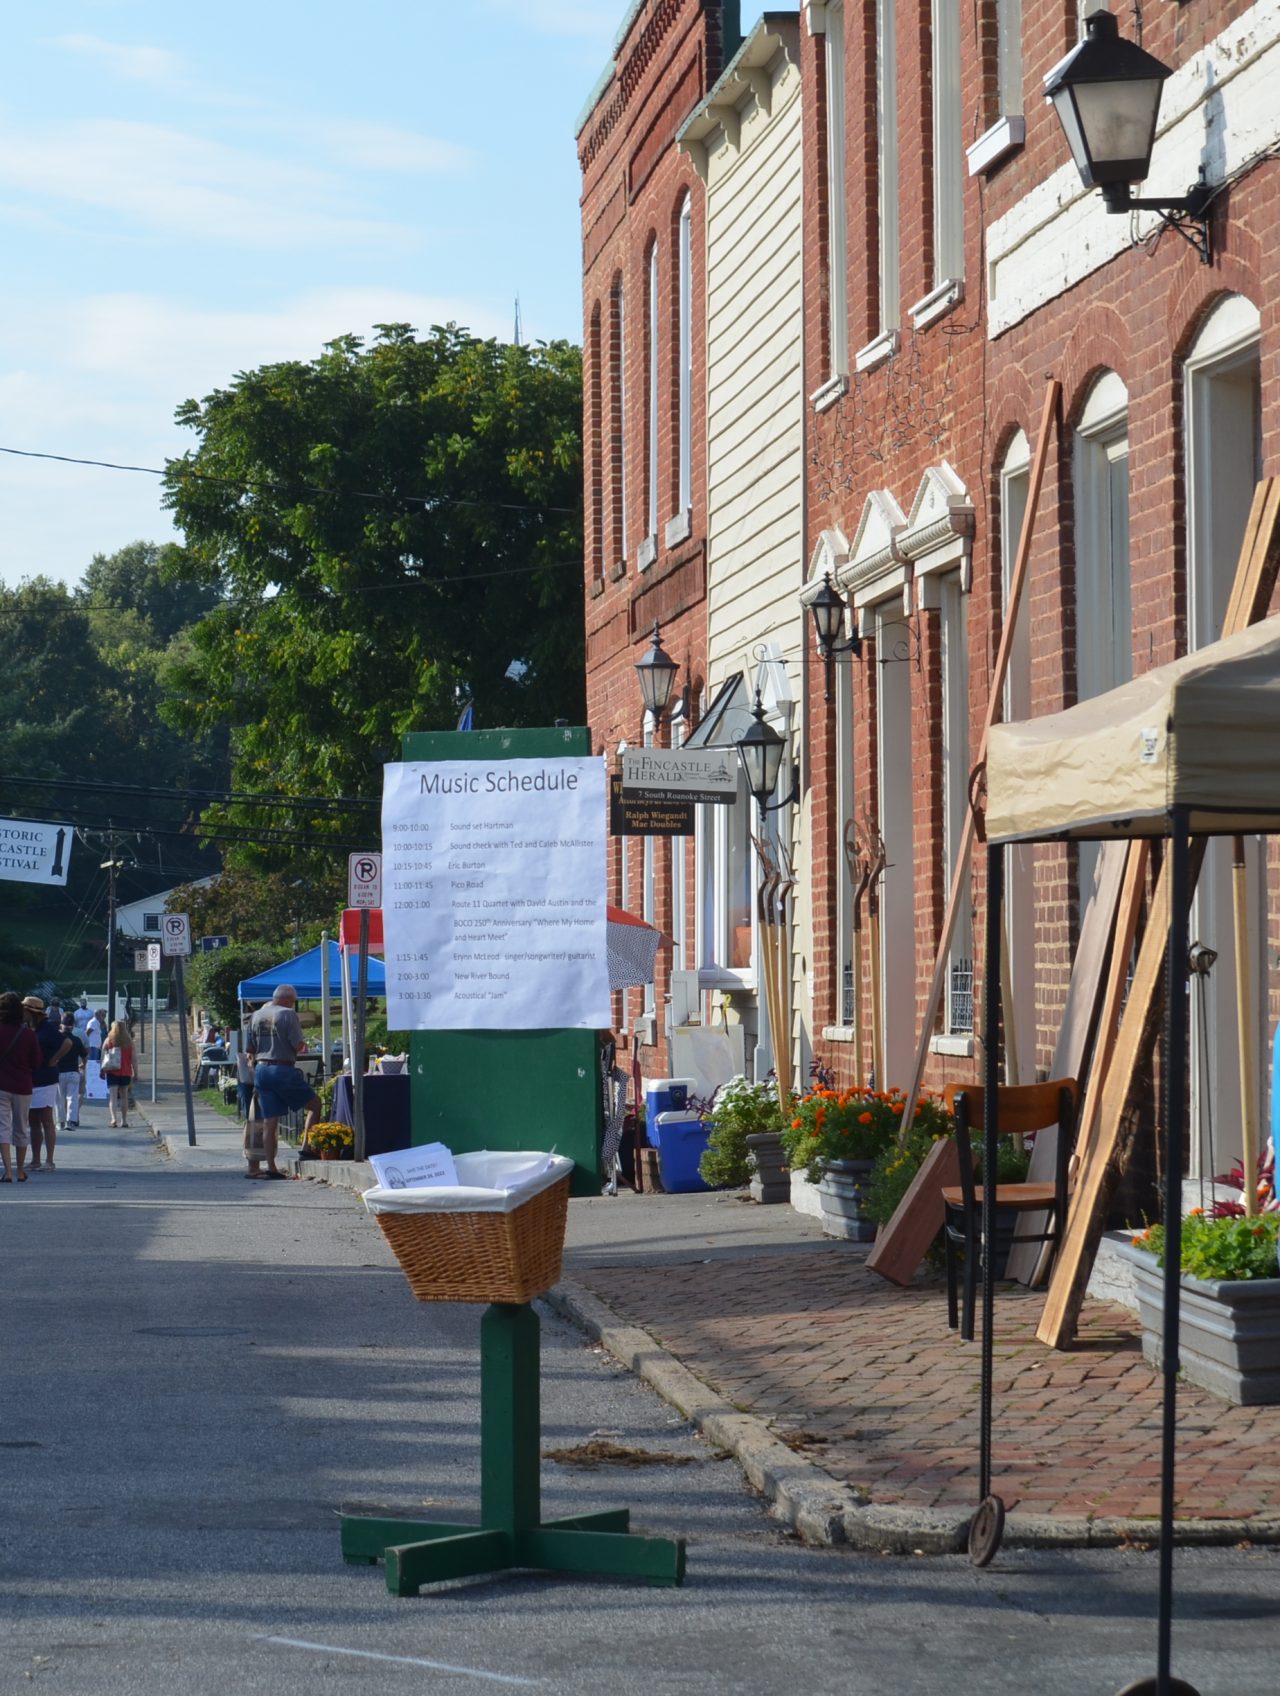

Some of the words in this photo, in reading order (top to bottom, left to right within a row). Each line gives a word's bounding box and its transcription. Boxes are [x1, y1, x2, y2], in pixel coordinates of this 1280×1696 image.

[641, 757, 712, 772] FINCASTLE
[628, 767, 683, 782] HERALD
[420, 772, 480, 795] Music
[484, 768, 578, 793] Schedule
[644, 791, 665, 799] South
[666, 791, 699, 800] Roanoke
[700, 792, 721, 801] Street
[625, 811, 649, 821] Ralph
[392, 823, 429, 832] 9:00-10:00
[450, 822, 471, 831] Sound
[484, 822, 514, 830] Hartman
[650, 820, 682, 828] Doubles
[393, 842, 433, 851] 10:00-10:15
[450, 842, 471, 850] Sound
[472, 841, 492, 850] check
[493, 841, 509, 849] with
[510, 840, 523, 848] Ted
[524, 840, 538, 848] and
[539, 840, 559, 848] Caleb
[560, 839, 594, 848] McAllister
[393, 862, 432, 871] 10:15-10:45
[448, 861, 461, 870] Eric
[462, 861, 486, 870] Burton
[394, 881, 434, 890] 11:00-11:45
[450, 880, 465, 889] Pico
[466, 880, 484, 889] Road
[394, 900, 431, 909] 12:00-1:00
[451, 900, 471, 909] Route
[472, 900, 480, 908] 11
[482, 900, 508, 909] Quartet
[509, 899, 526, 908] with
[526, 899, 546, 907] David
[548, 898, 569, 907] Austin
[570, 898, 583, 906] and
[585, 898, 597, 906] the
[493, 919, 532, 928] Anniversary
[561, 918, 573, 928] My
[574, 918, 595, 926] Home
[454, 933, 467, 942] and
[468, 933, 486, 941] Heart
[396, 952, 429, 961] 1:15-1:45
[473, 952, 500, 961] McLeod
[397, 972, 430, 981] 2:00-3:00
[454, 972, 469, 980] New
[470, 972, 487, 980] River
[488, 972, 510, 980] Bound
[454, 991, 487, 1000] Acoustical
